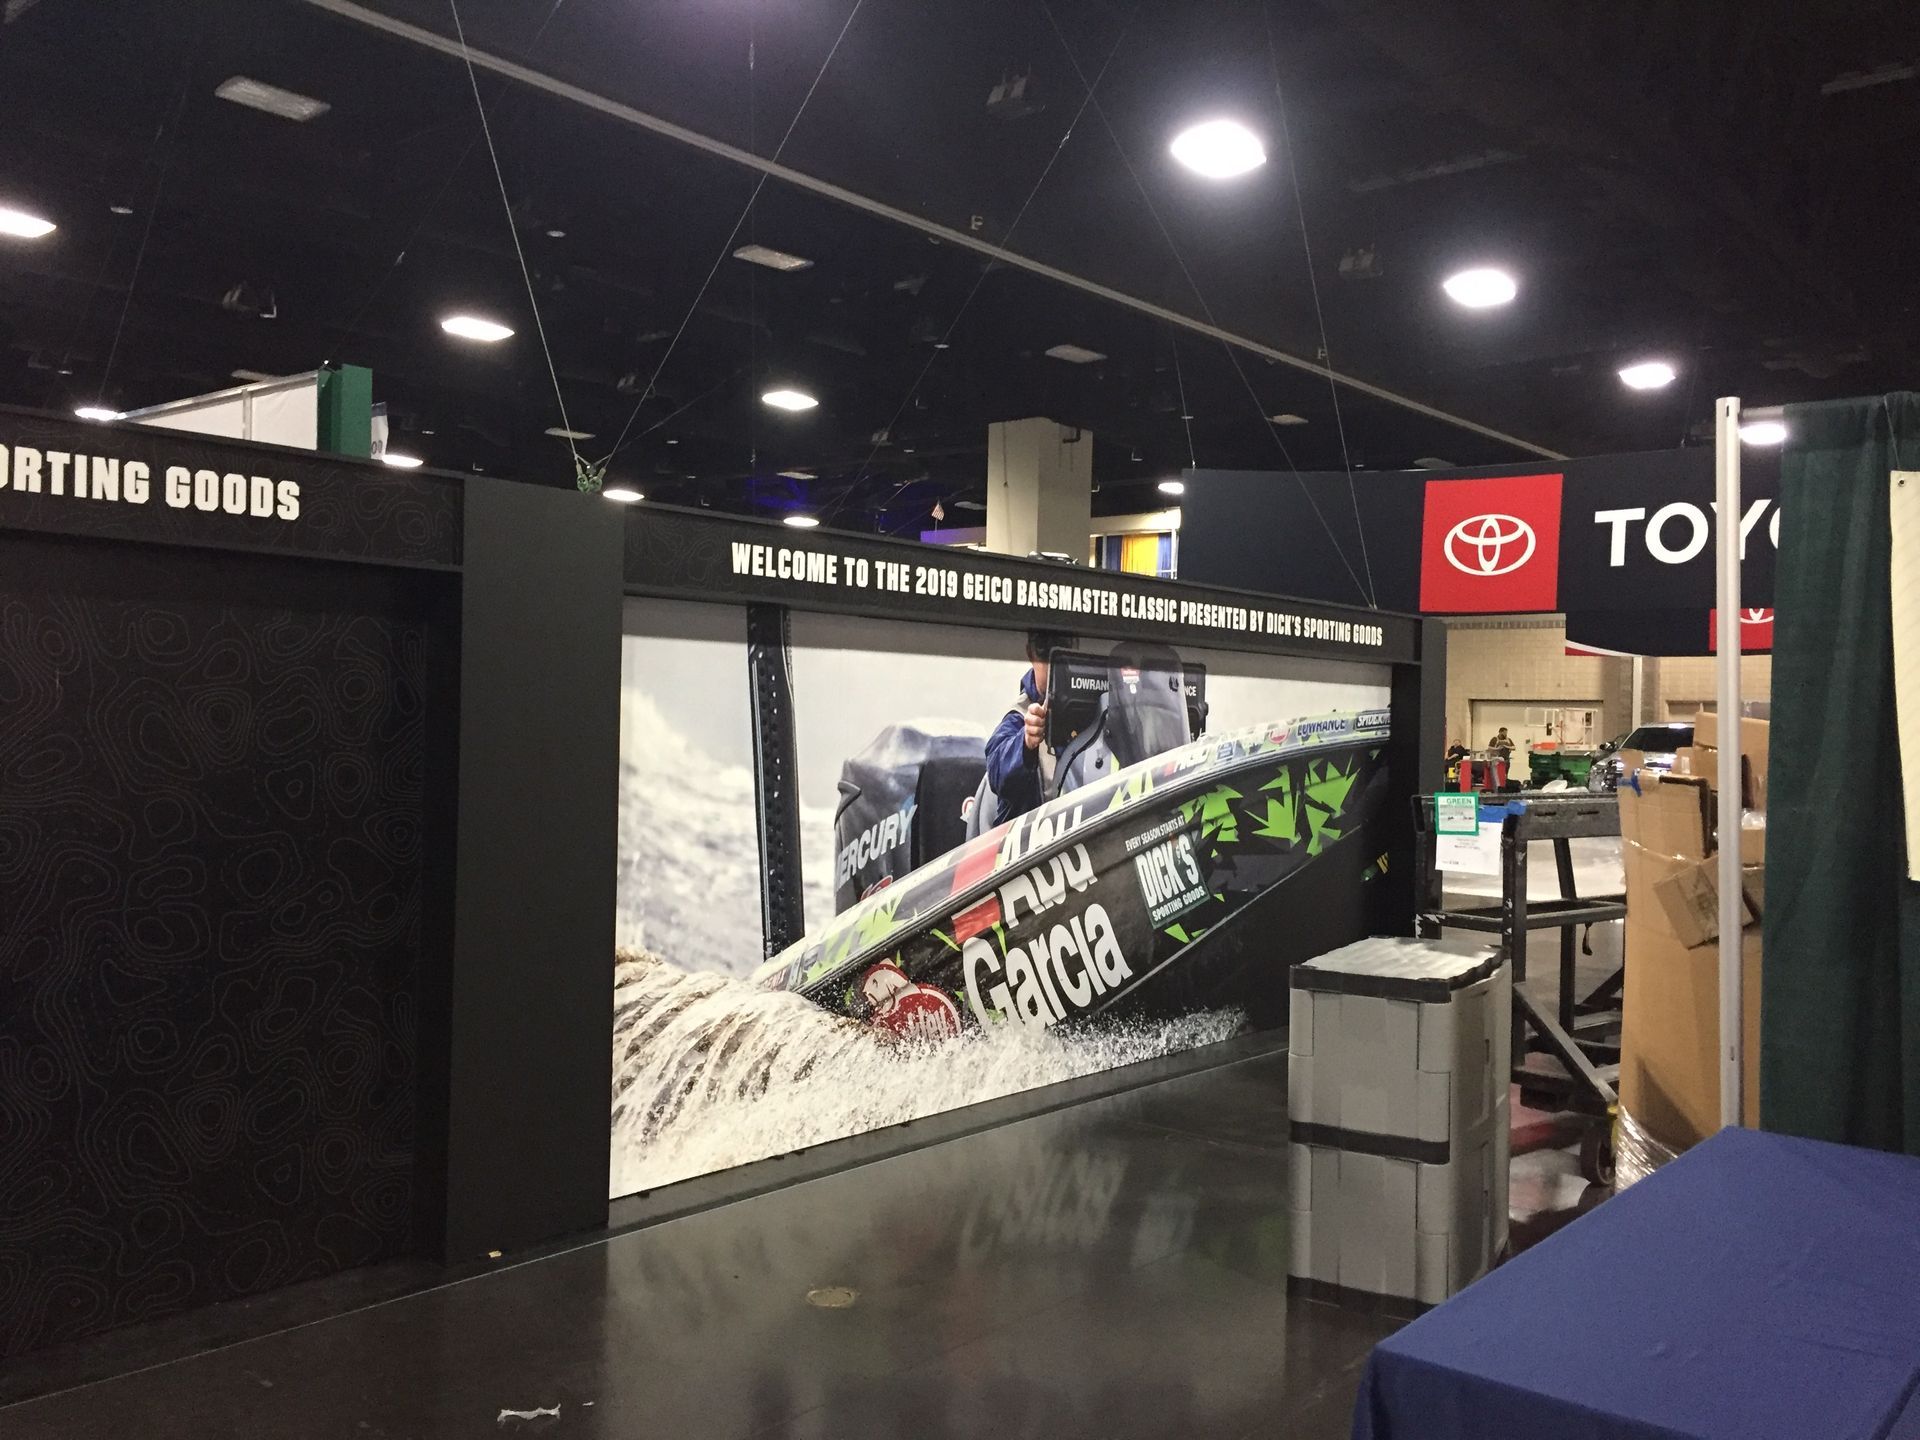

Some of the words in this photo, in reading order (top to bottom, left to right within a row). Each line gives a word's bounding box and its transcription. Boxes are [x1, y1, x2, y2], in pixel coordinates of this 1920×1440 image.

[166, 465, 300, 521] GOODS
[1595, 498, 1780, 567] TOY
[732, 542, 837, 585] WELCOME
[844, 557, 869, 588] TO
[875, 561, 910, 593] THE
[916, 566, 958, 598] 2019
[963, 573, 1013, 604] GEICO
[1017, 580, 1118, 617] BASSMASTER
[1121, 593, 1178, 623] CLASSIC
[1180, 600, 1247, 631] PRESENTED
[1250, 609, 1265, 632] BY
[1267, 612, 1302, 637] DICK'S
[1304, 617, 1351, 643] SPORTING
[1353, 626, 1383, 647] GOODS
[1297, 719, 1346, 737] LOWRANCE
[1125, 836, 1141, 852] EVERY
[1141, 826, 1161, 843] SEASON
[1160, 817, 1179, 836] STARTS
[1176, 815, 1185, 827] AT
[1152, 897, 1183, 921] SPORTING
[1183, 886, 1205, 905] GOODS
